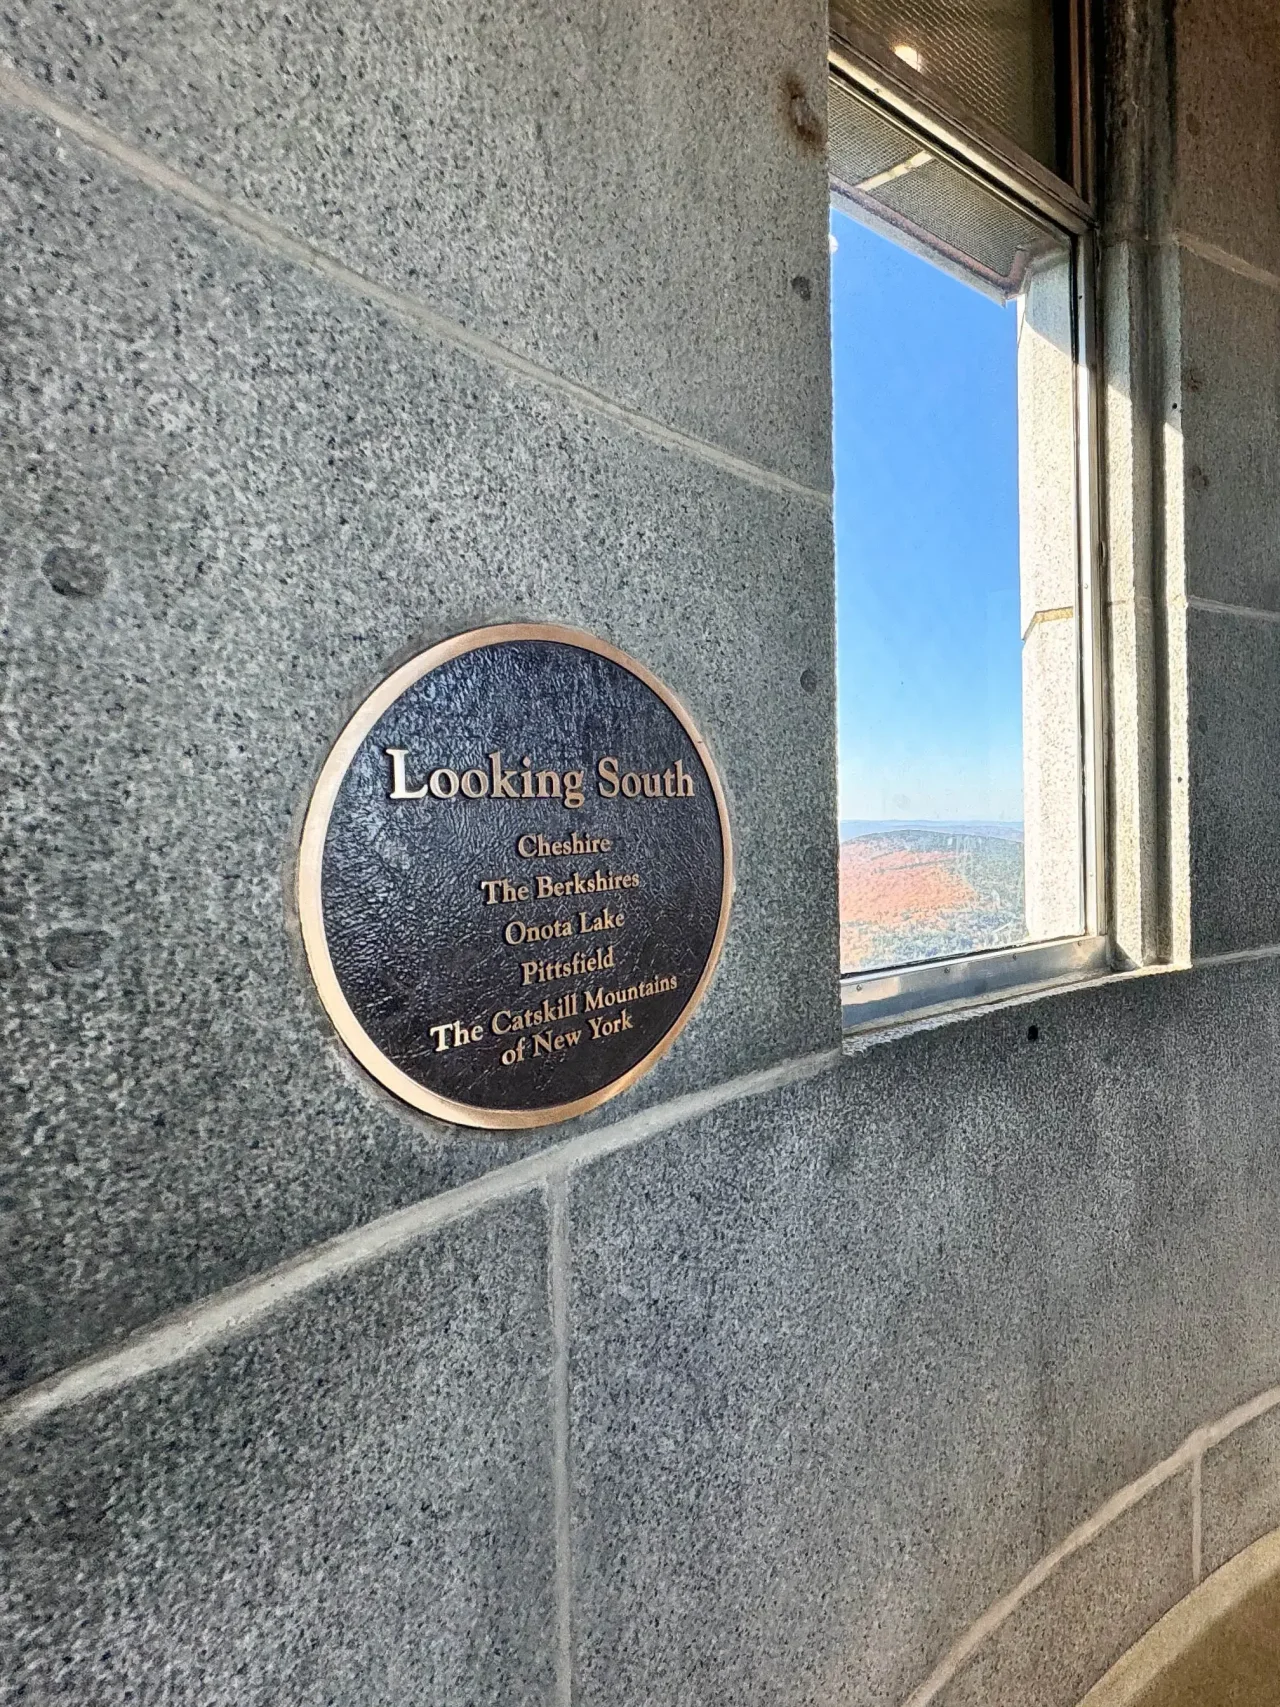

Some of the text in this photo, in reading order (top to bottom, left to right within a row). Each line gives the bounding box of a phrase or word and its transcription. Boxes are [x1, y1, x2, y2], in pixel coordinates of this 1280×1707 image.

[386, 748, 695, 808] Looking South
[518, 833, 611, 859] Cheshire
[481, 870, 639, 905] The Berkshires
[505, 910, 625, 946] Onota Lake
[521, 947, 614, 985] Pittsfield
[430, 973, 678, 1052] The Catskill Mountains
[501, 1010, 633, 1067] of New York
